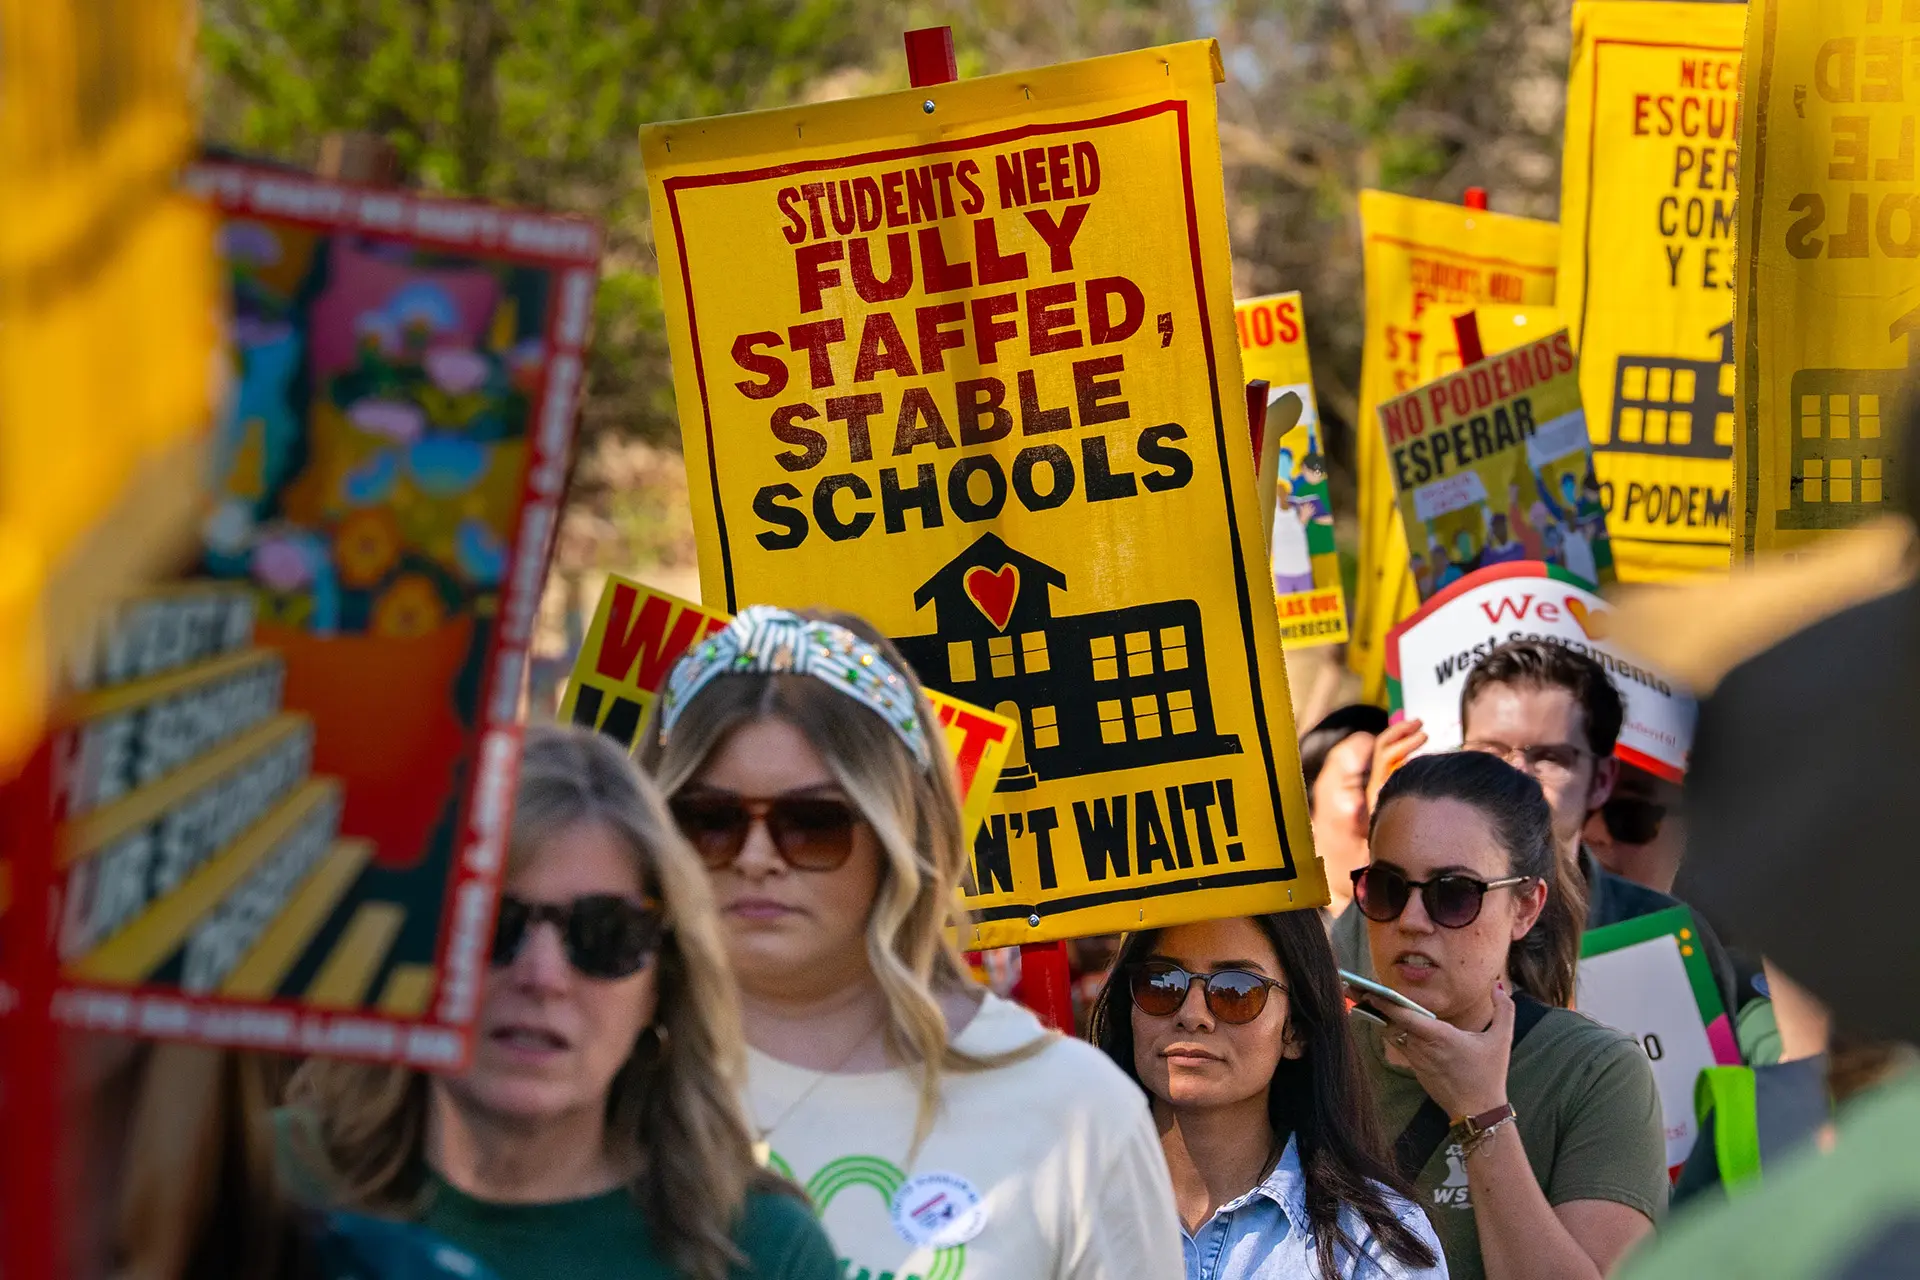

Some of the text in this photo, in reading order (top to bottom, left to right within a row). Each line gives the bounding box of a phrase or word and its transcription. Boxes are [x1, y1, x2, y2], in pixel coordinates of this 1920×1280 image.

[777, 140, 1101, 244] STUDENTS NEED
[795, 202, 1091, 314] FULLY
[1665, 245, 1684, 288] Y
[730, 276, 1175, 400] STAFFED,
[1382, 333, 1574, 446] NO PODEMOS
[769, 354, 1131, 472] STABLE
[1392, 398, 1537, 491] ESPERAR
[751, 422, 1194, 551] SCHOOLS
[595, 583, 729, 693] W
[1434, 634, 1497, 686] West
[1480, 593, 1560, 625] We
[1071, 778, 1246, 882] WAIT!
